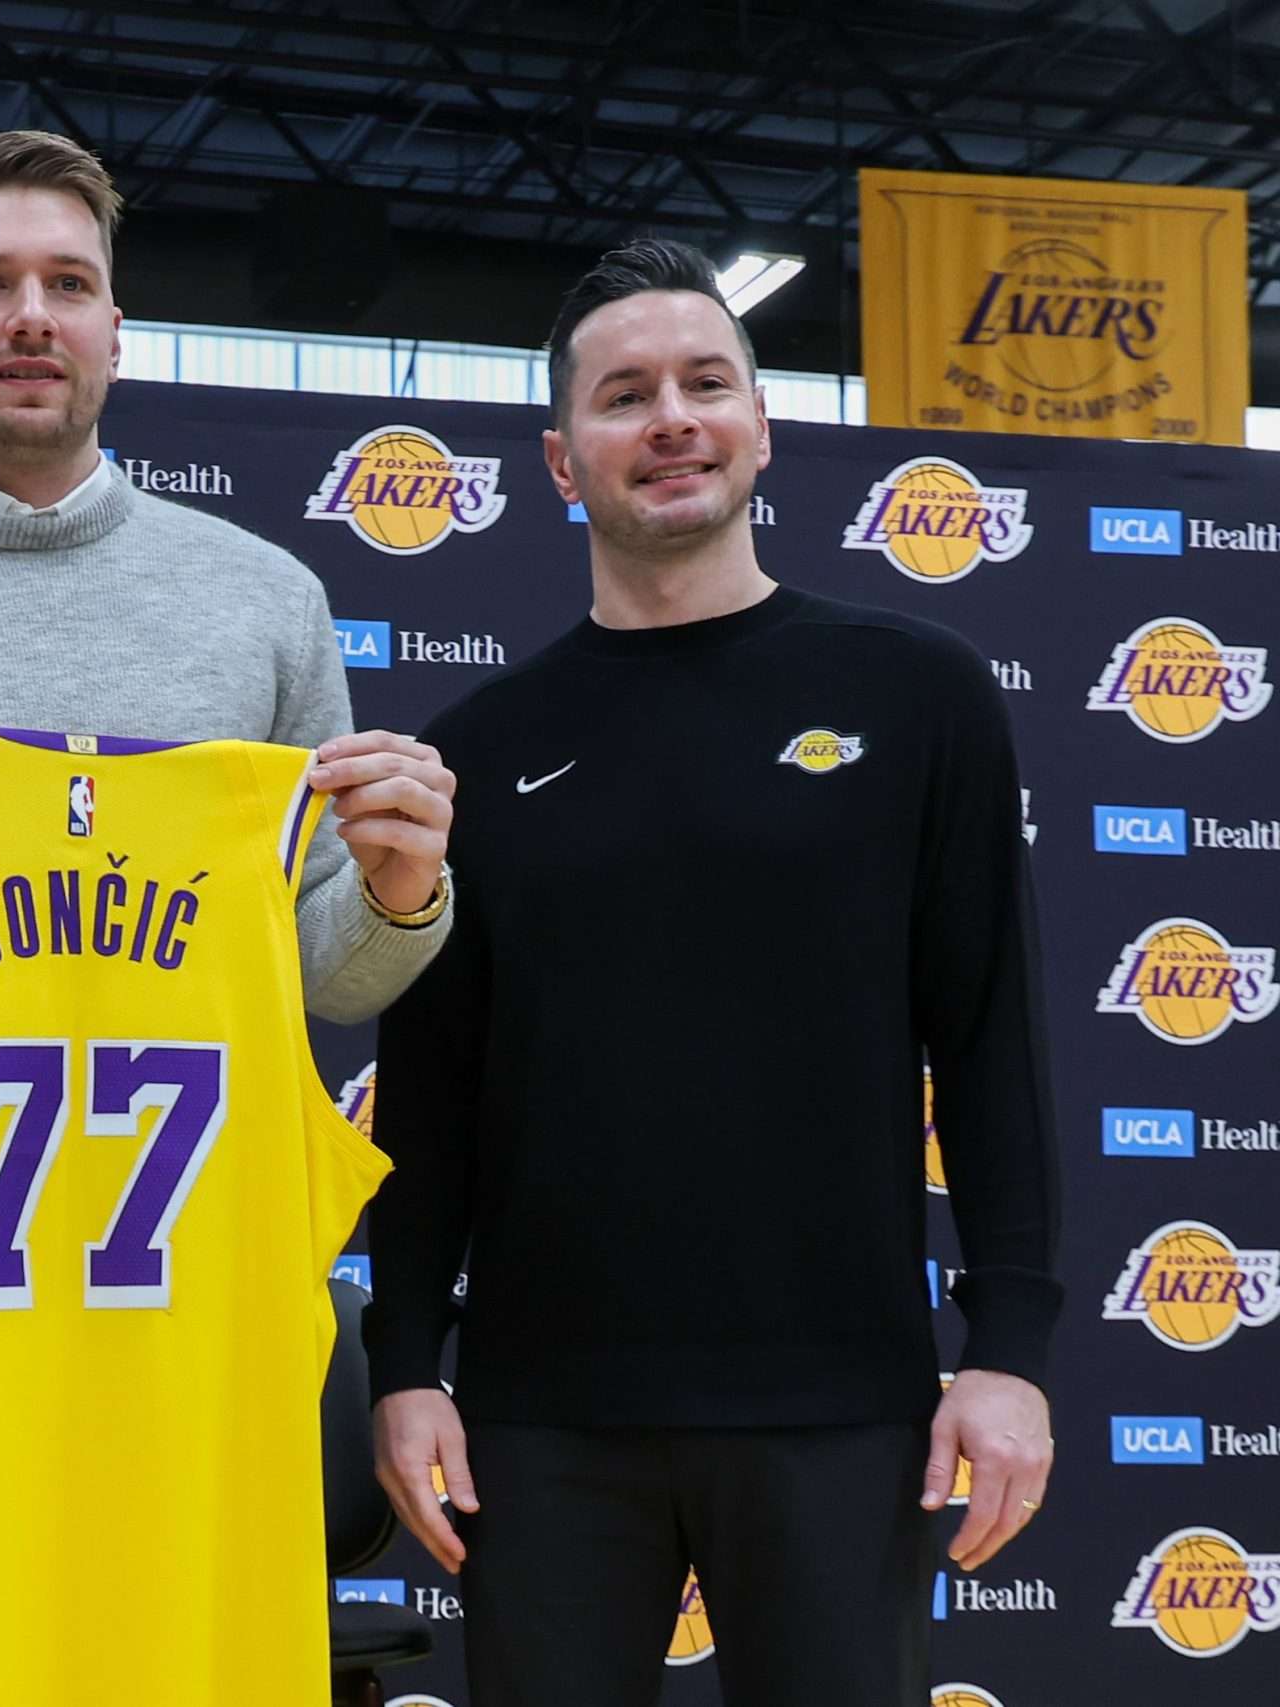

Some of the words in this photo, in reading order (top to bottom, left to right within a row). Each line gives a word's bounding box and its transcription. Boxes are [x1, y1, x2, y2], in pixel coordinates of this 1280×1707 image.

[952, 271, 1170, 361] LAKERS
[943, 365, 1029, 416] WORLD
[1036, 372, 1173, 423] CHAMPIONS
[123, 458, 234, 496] Health
[374, 457, 406, 469] LOS
[408, 459, 492, 474] ANGELES
[318, 456, 497, 525] LAKERS
[907, 488, 938, 499] LOS
[941, 490, 1017, 504] ANGELES
[856, 487, 1023, 554] LAKERS
[1102, 519, 1170, 544] UCLA
[398, 630, 506, 665] Health
[1149, 649, 1180, 660] LOS
[1182, 651, 1257, 663] ANGELES
[1101, 649, 1262, 713] LAKERS
[1106, 816, 1175, 844] UCLA
[1158, 950, 1189, 961] LOS
[1190, 952, 1266, 964] ANGELES
[1113, 950, 1272, 1014] LAKERS
[1113, 1119, 1184, 1146] UCLA
[1202, 1119, 1280, 1151] Healt
[1122, 1255, 1278, 1318] LAKERS
[1123, 1427, 1193, 1453] UCLA
[954, 1578, 1057, 1611] Health
[1130, 1562, 1280, 1623] LAKERS
